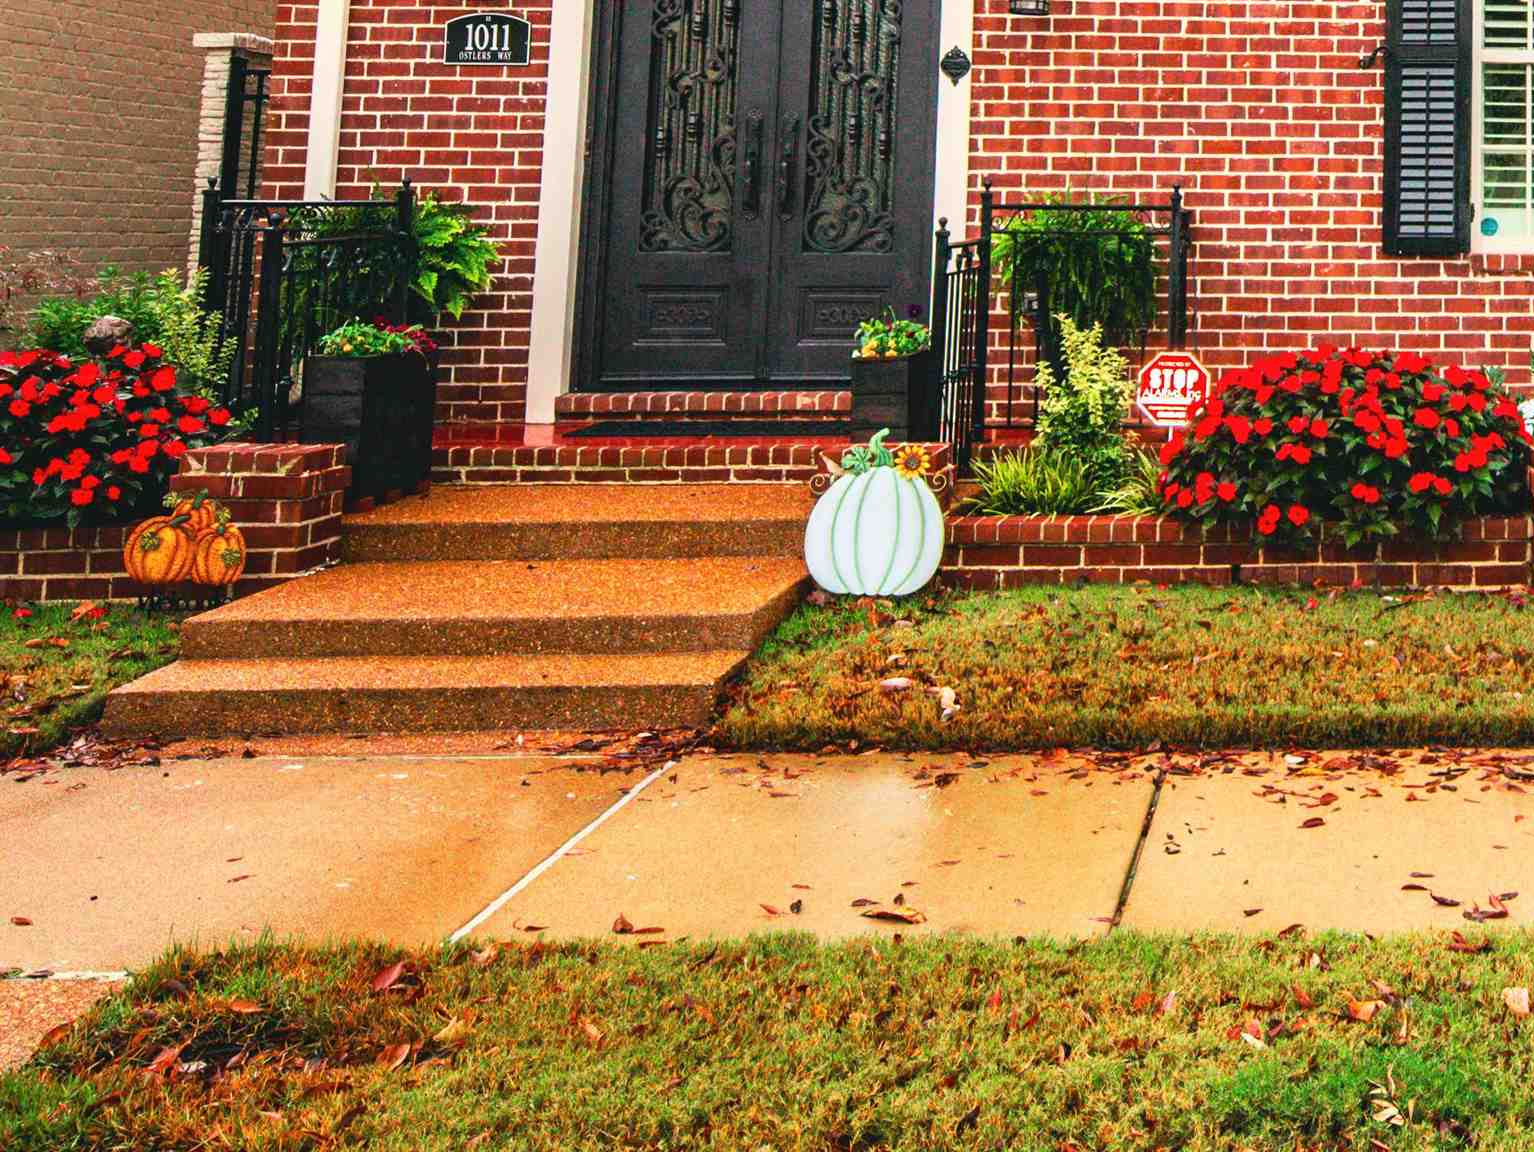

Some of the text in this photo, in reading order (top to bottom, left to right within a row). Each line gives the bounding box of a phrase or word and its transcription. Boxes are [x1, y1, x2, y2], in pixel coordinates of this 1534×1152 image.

[464, 23, 510, 51] 1011
[458, 51, 512, 61] OSTLERS WAY
[1149, 368, 1199, 390] STOP
